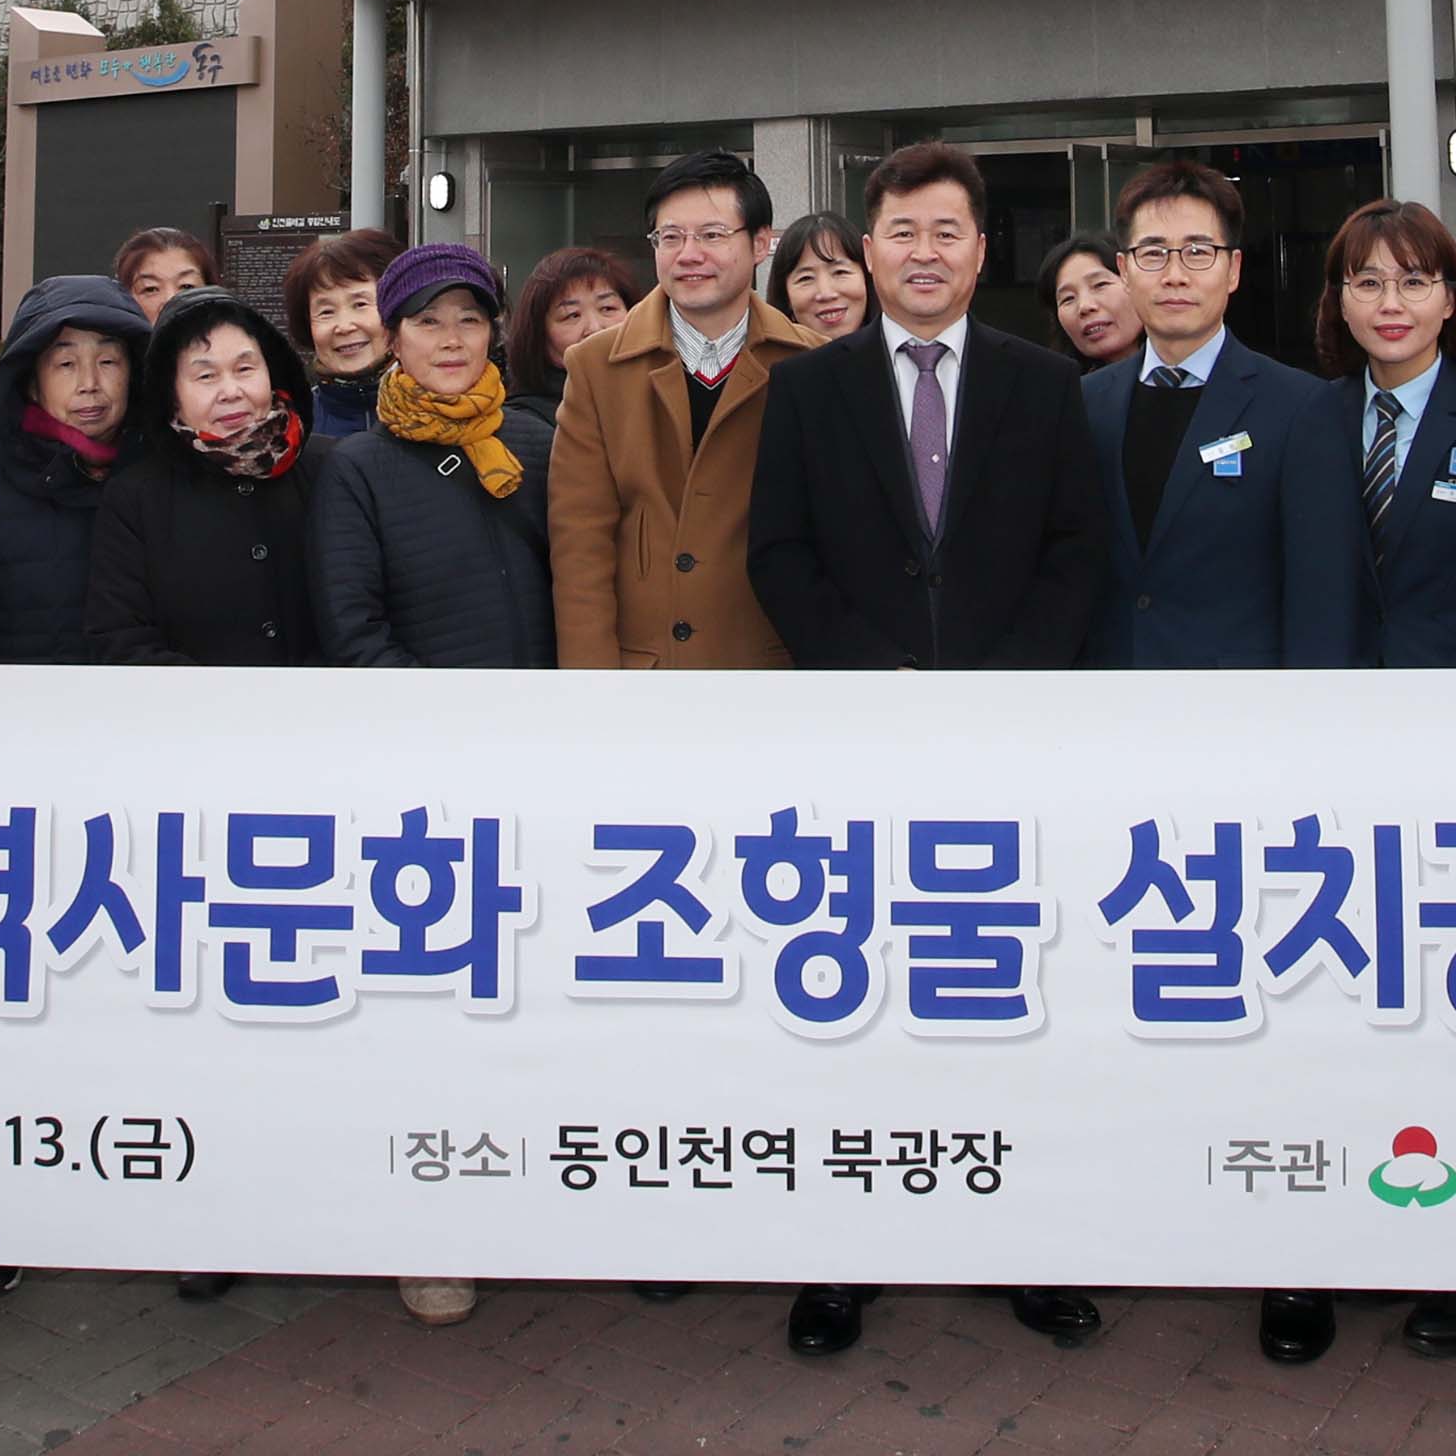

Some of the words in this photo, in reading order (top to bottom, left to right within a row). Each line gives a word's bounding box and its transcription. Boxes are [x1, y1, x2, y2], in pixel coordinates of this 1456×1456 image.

[574, 805, 1041, 1024] 조형물
[4, 1113, 196, 1183] 13.(금)
[403, 1127, 515, 1183] 장소
[549, 1123, 798, 1192] 동인천역
[822, 1128, 1012, 1195] 북광장
[1220, 1137, 1332, 1194] 주관
